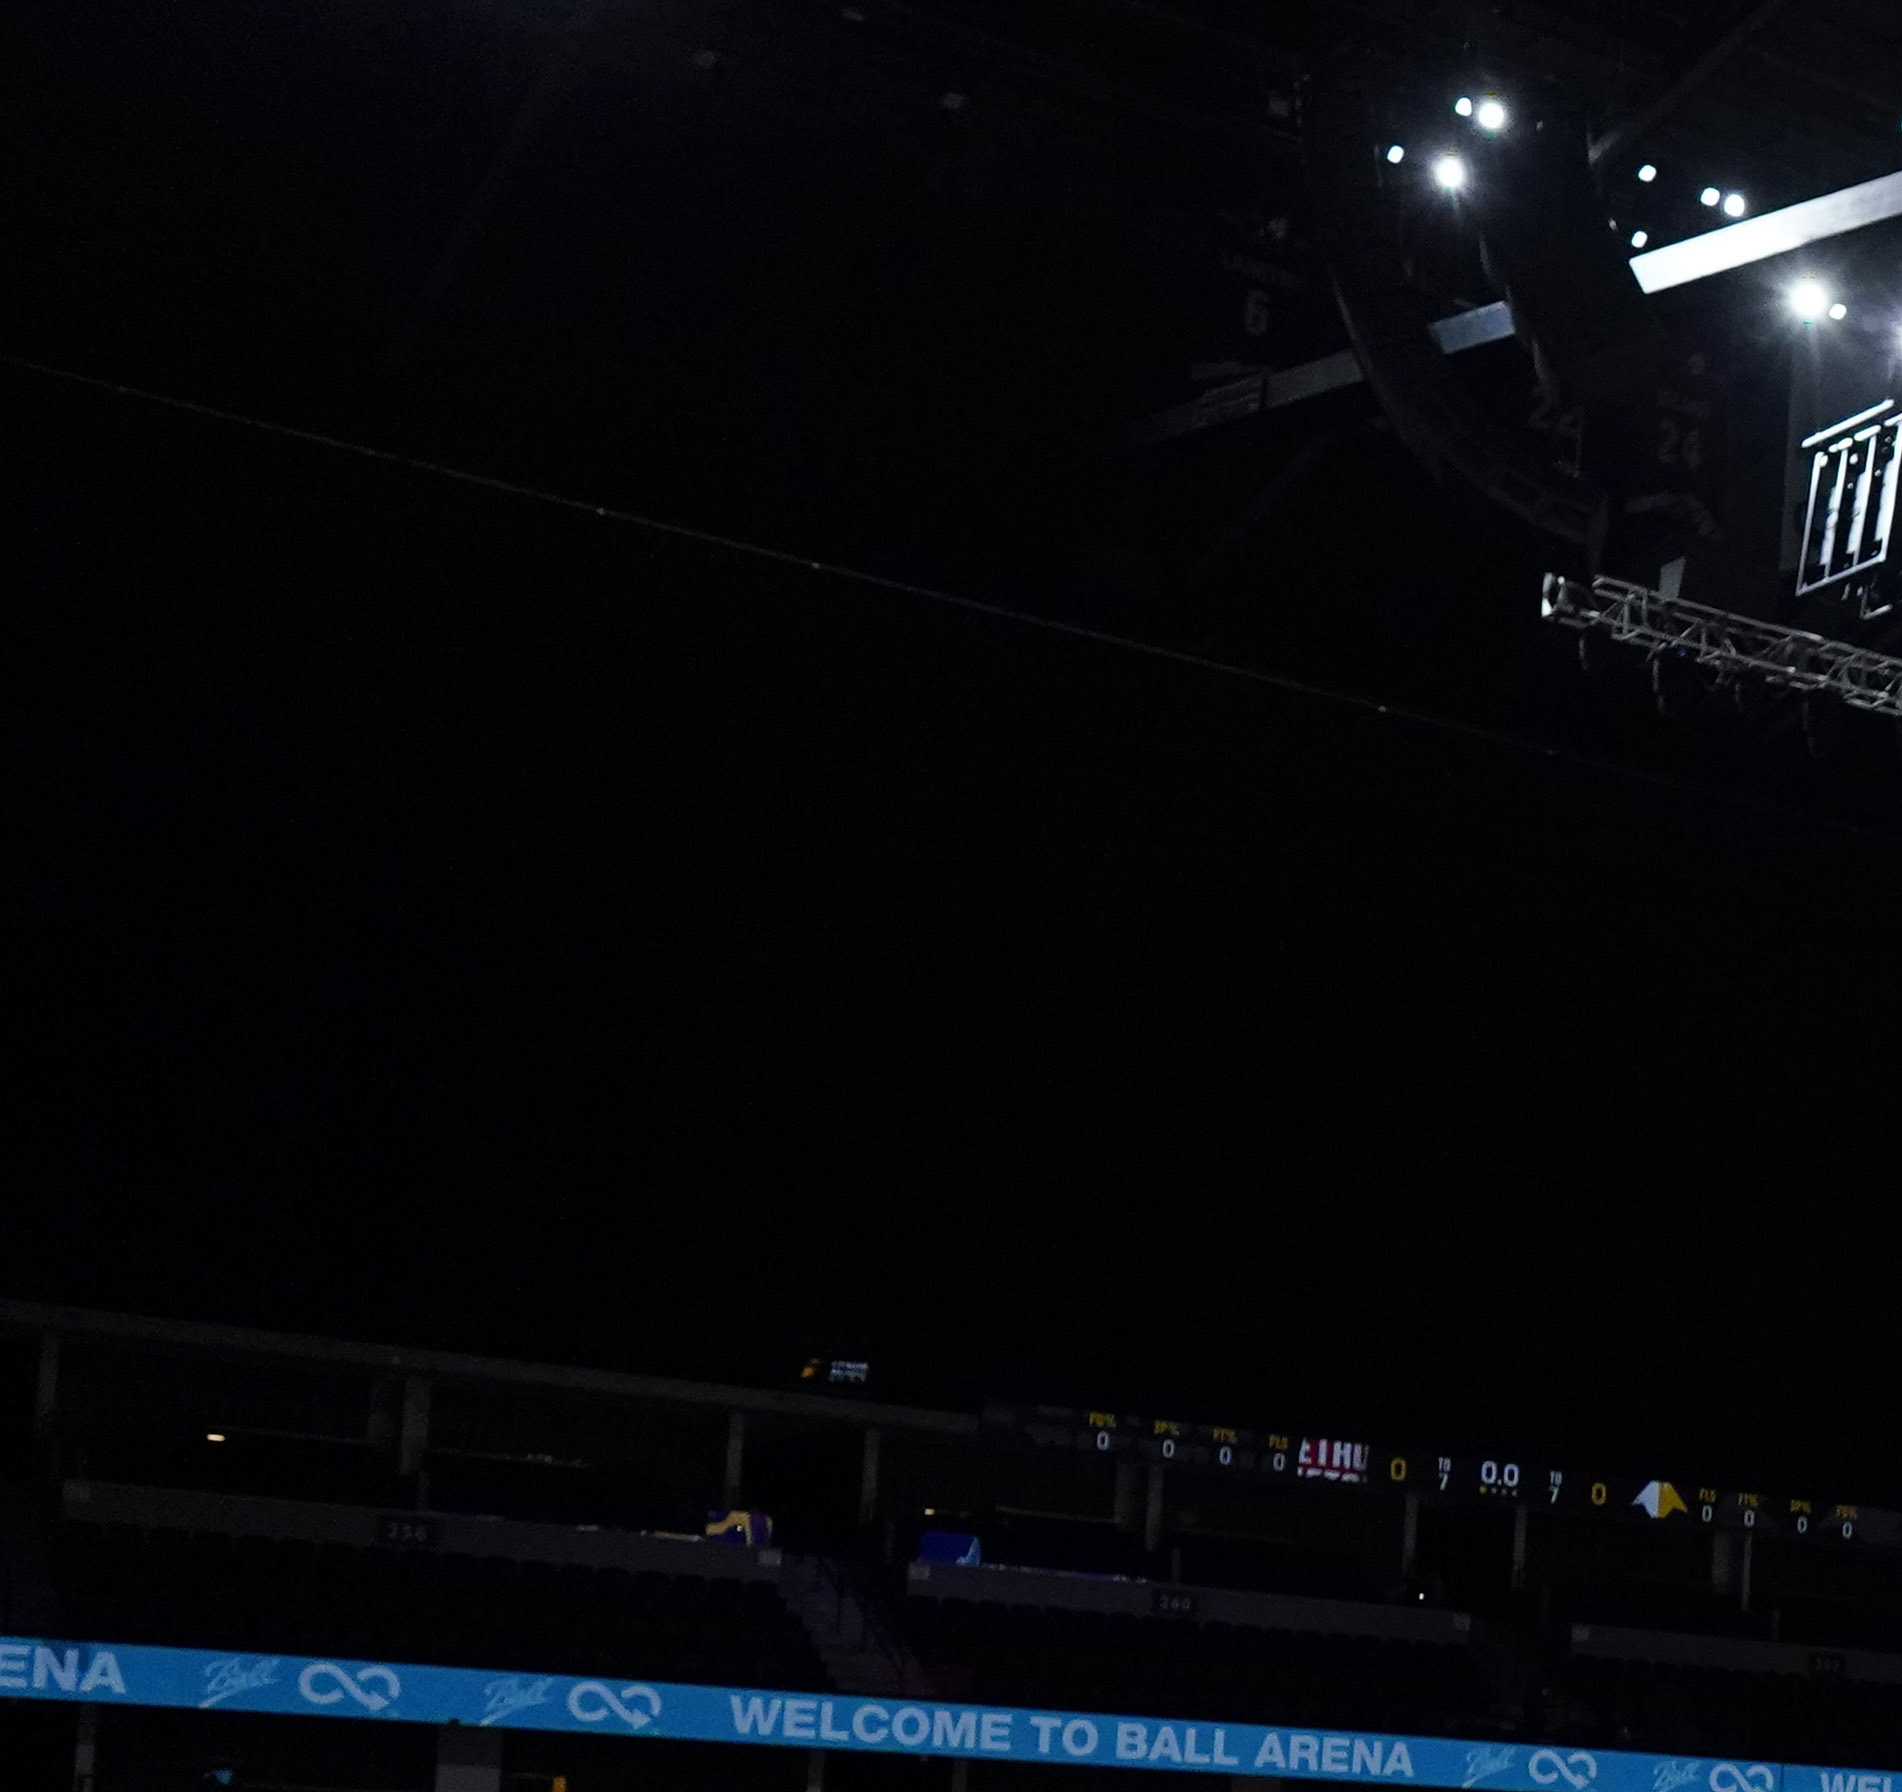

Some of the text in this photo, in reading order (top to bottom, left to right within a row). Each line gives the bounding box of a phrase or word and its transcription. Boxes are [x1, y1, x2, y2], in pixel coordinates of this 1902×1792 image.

[1097, 1430, 1286, 1472] 0 0 0 0
[1389, 1456, 1407, 1482] 0
[1480, 1460, 1520, 1488] 0.0
[1590, 1482, 1608, 1506] 0
[1702, 1504, 1854, 1540] 0 0 0 0
[730, 1694, 1416, 1779] WELCOME TO BALL ARENA
